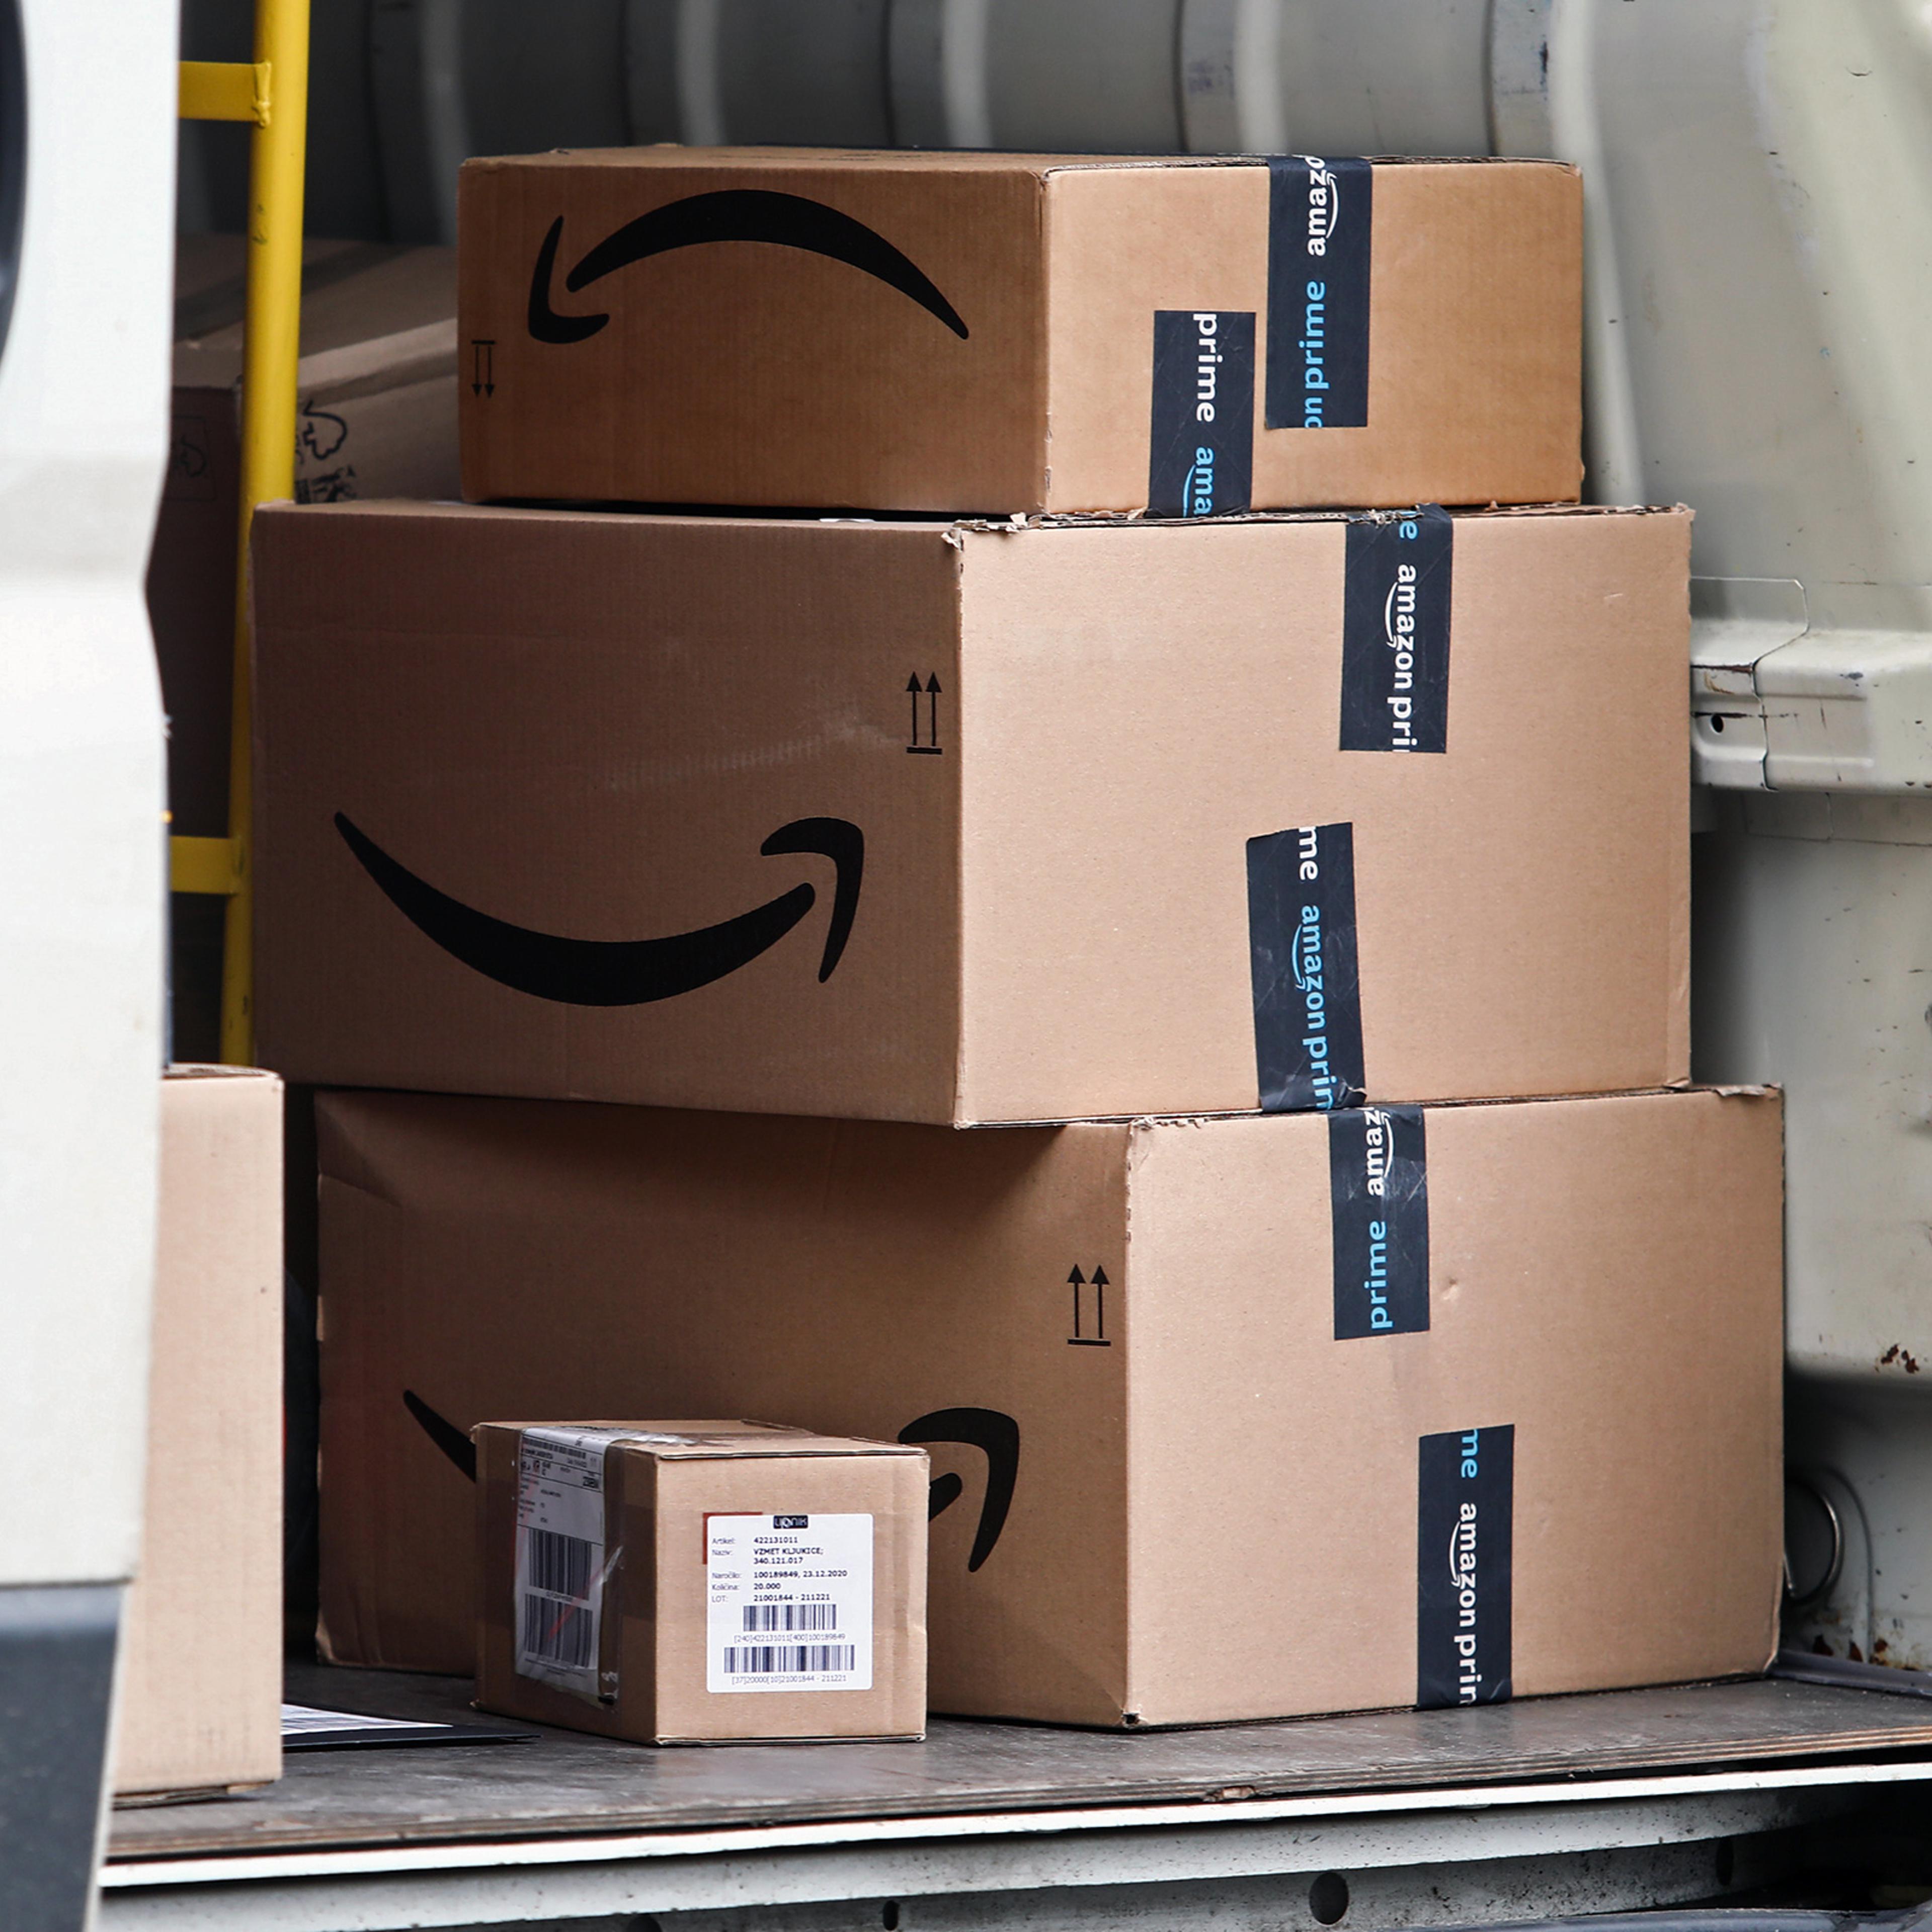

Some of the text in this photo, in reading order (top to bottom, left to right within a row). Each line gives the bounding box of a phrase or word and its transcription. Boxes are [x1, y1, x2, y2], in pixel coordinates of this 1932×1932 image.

[1305, 155, 1327, 256] amazo
[1193, 313, 1223, 422] prime
[1299, 281, 1329, 389] prime
[1394, 565, 1416, 689] amazon
[1387, 697, 1417, 752] pri
[1302, 905, 1325, 1029] amazon
[1364, 1107, 1393, 1329] prime amaz
[1459, 1503, 1477, 1627] amazon
